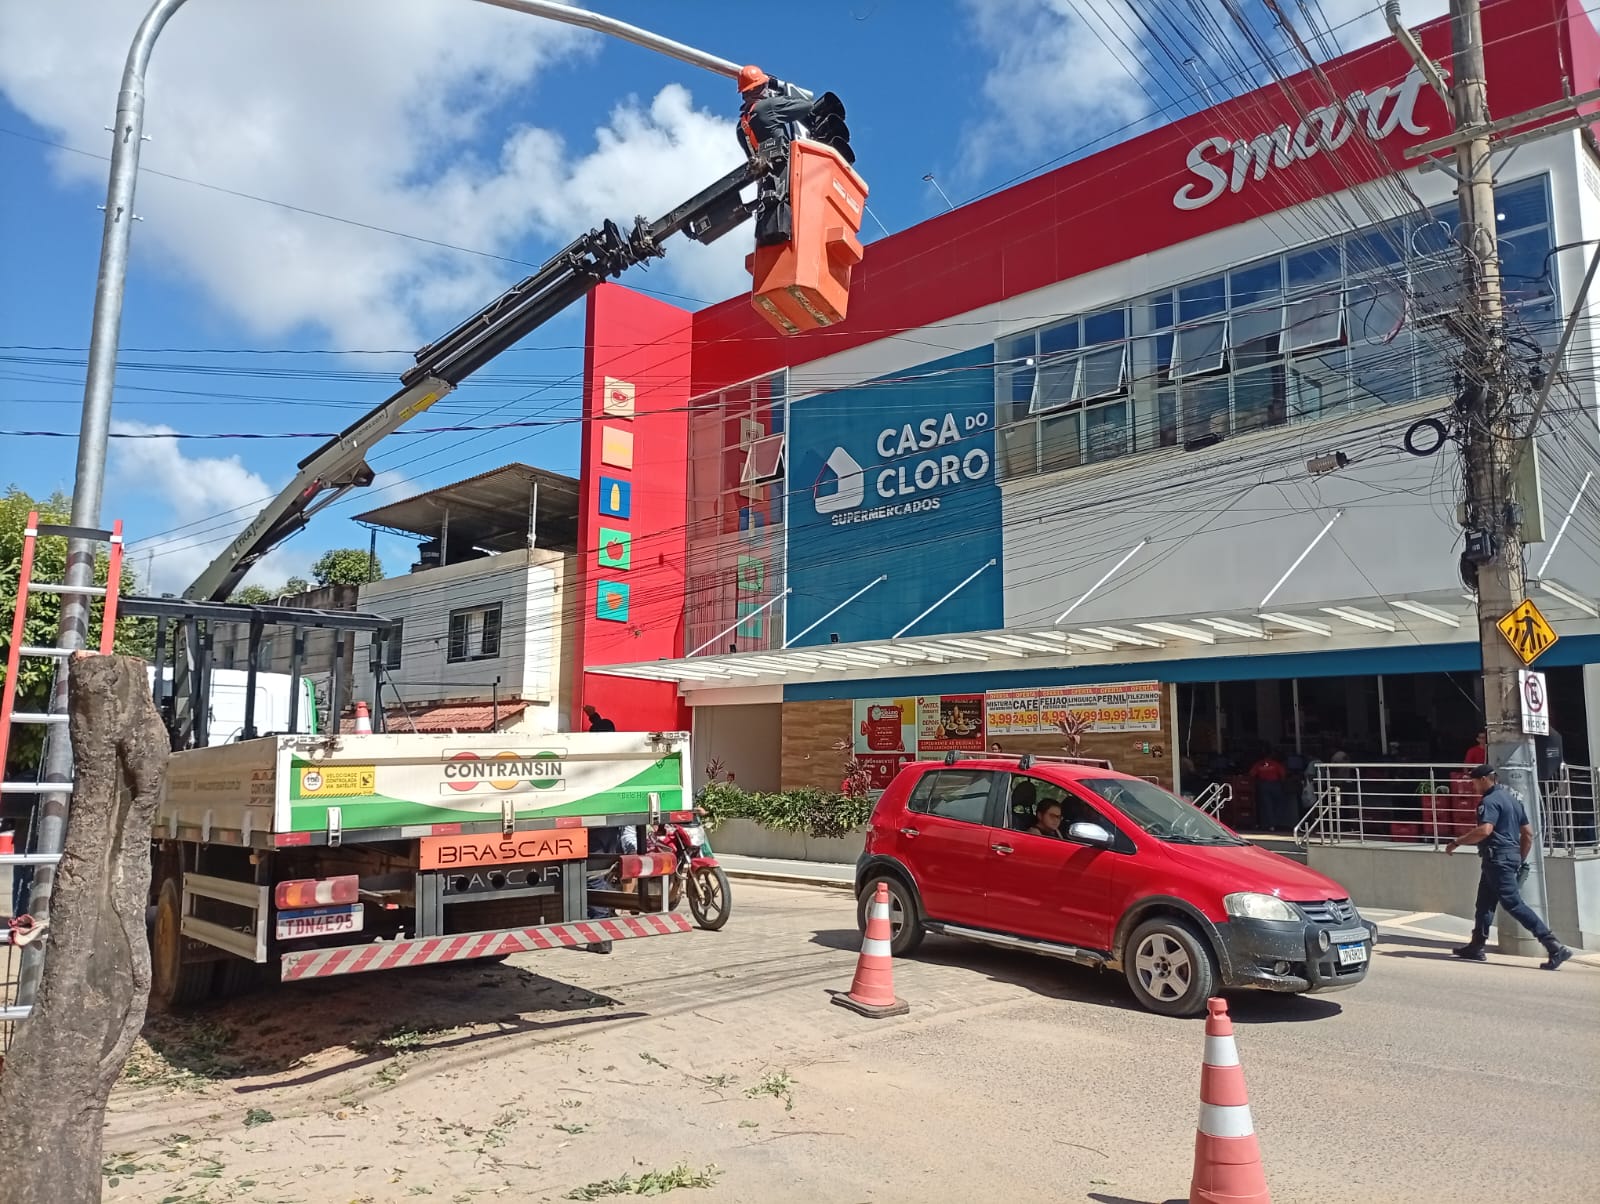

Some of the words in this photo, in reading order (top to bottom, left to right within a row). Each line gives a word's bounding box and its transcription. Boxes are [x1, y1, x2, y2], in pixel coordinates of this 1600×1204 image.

[1172, 64, 1450, 210] Smart
[876, 412, 962, 458] CASA
[964, 411, 989, 431] DO
[875, 447, 990, 498] CLORO
[831, 497, 941, 526] SUPERMERCADOS
[1097, 693, 1126, 703] PERNIL
[444, 762, 563, 779] CONTRANSIN
[438, 838, 574, 864] BRASCAR
[286, 914, 354, 936] TDN4E95
